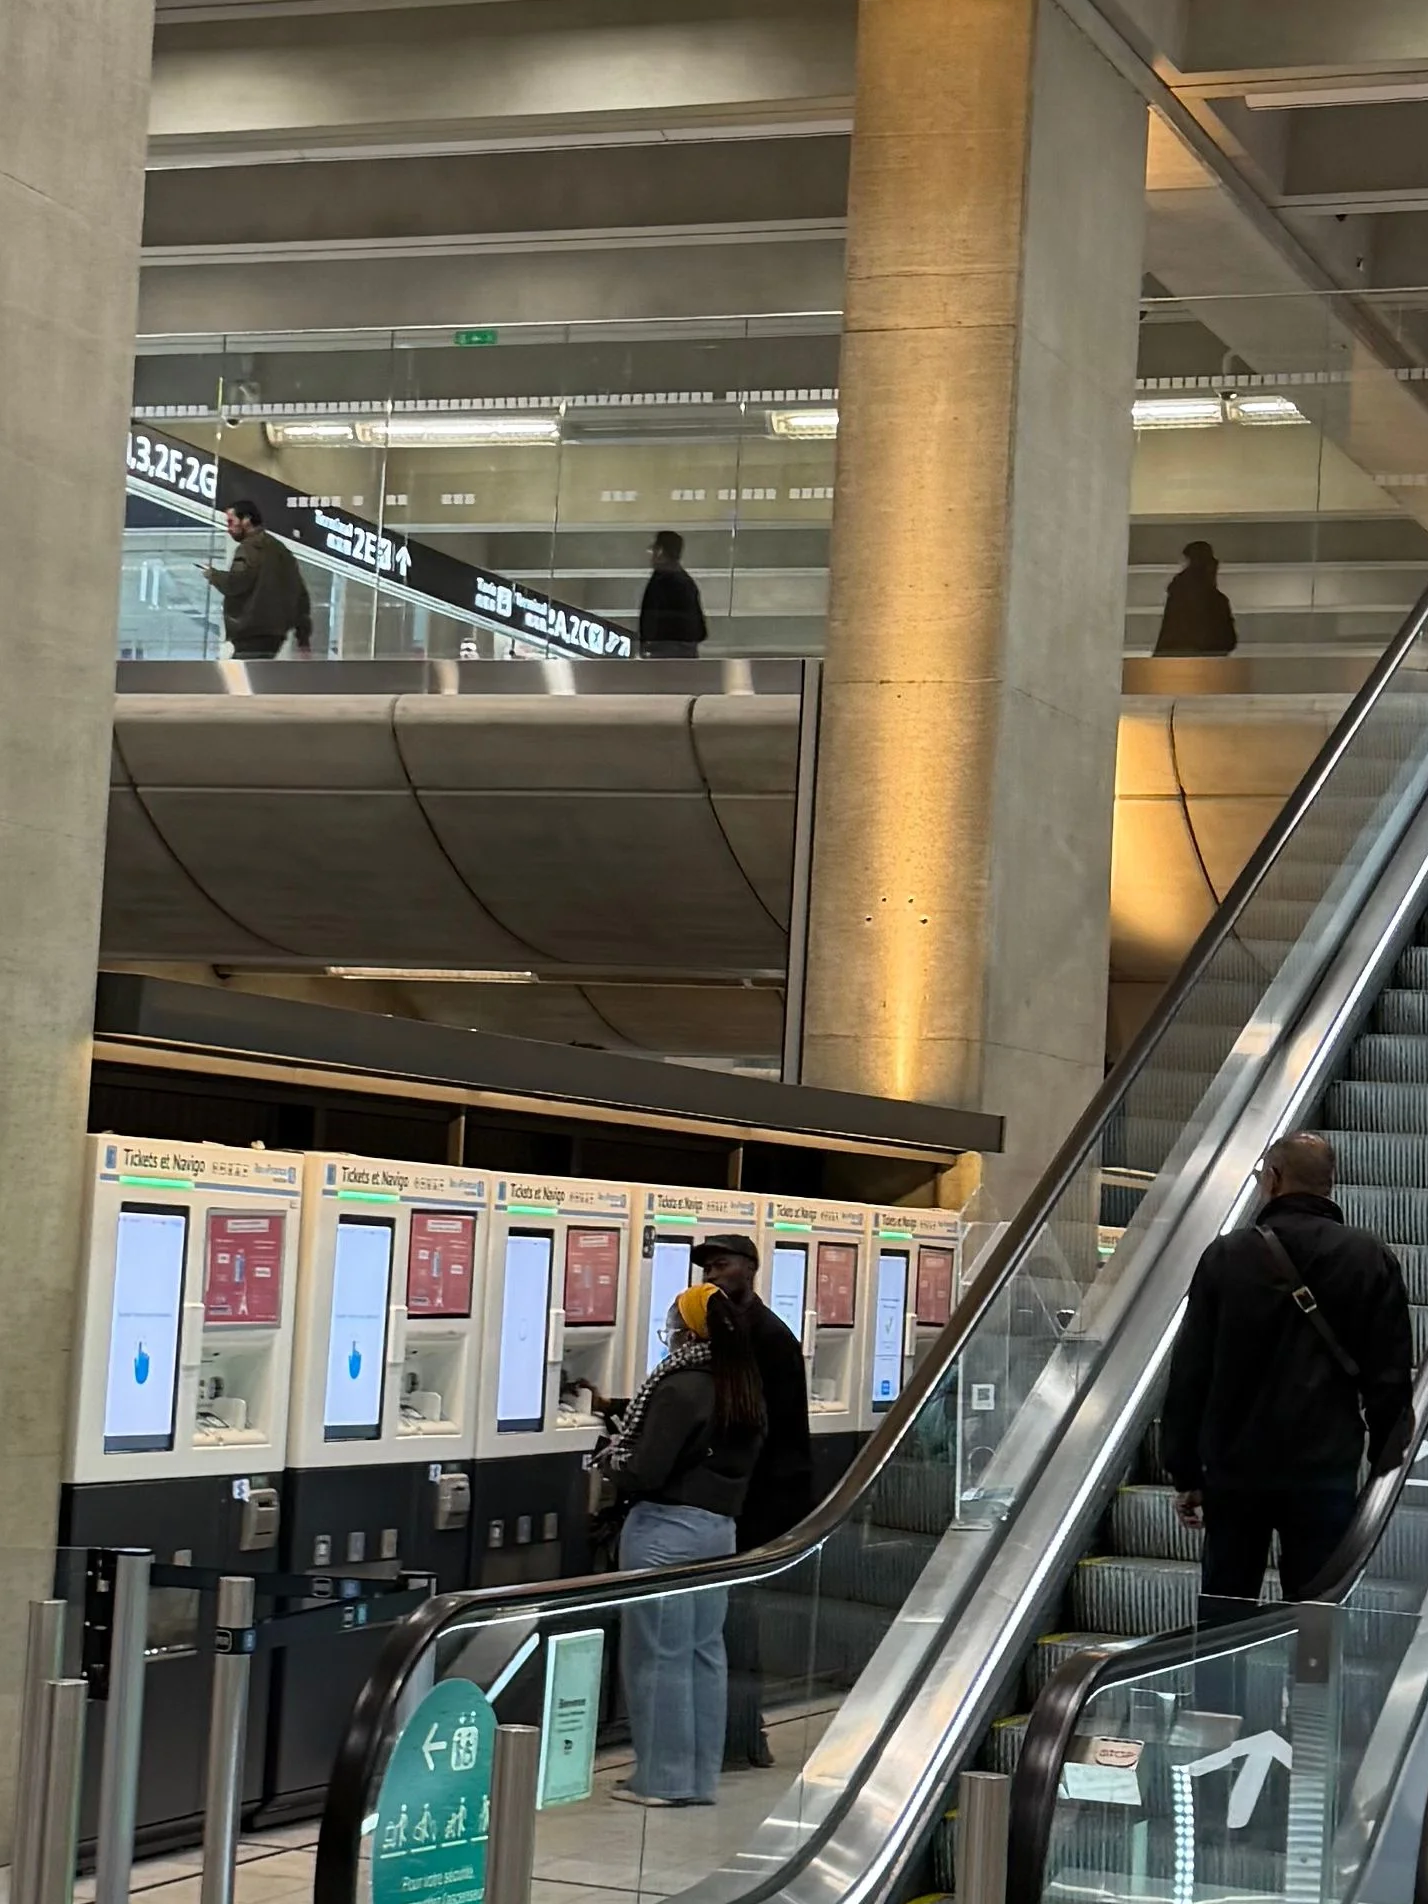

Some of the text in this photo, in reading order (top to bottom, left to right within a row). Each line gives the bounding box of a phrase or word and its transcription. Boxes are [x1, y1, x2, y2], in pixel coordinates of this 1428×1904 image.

[124, 1148, 206, 1176] Tickets et Navigo
[342, 1166, 370, 1184] Tickets
[382, 1171, 409, 1191] Navigo
